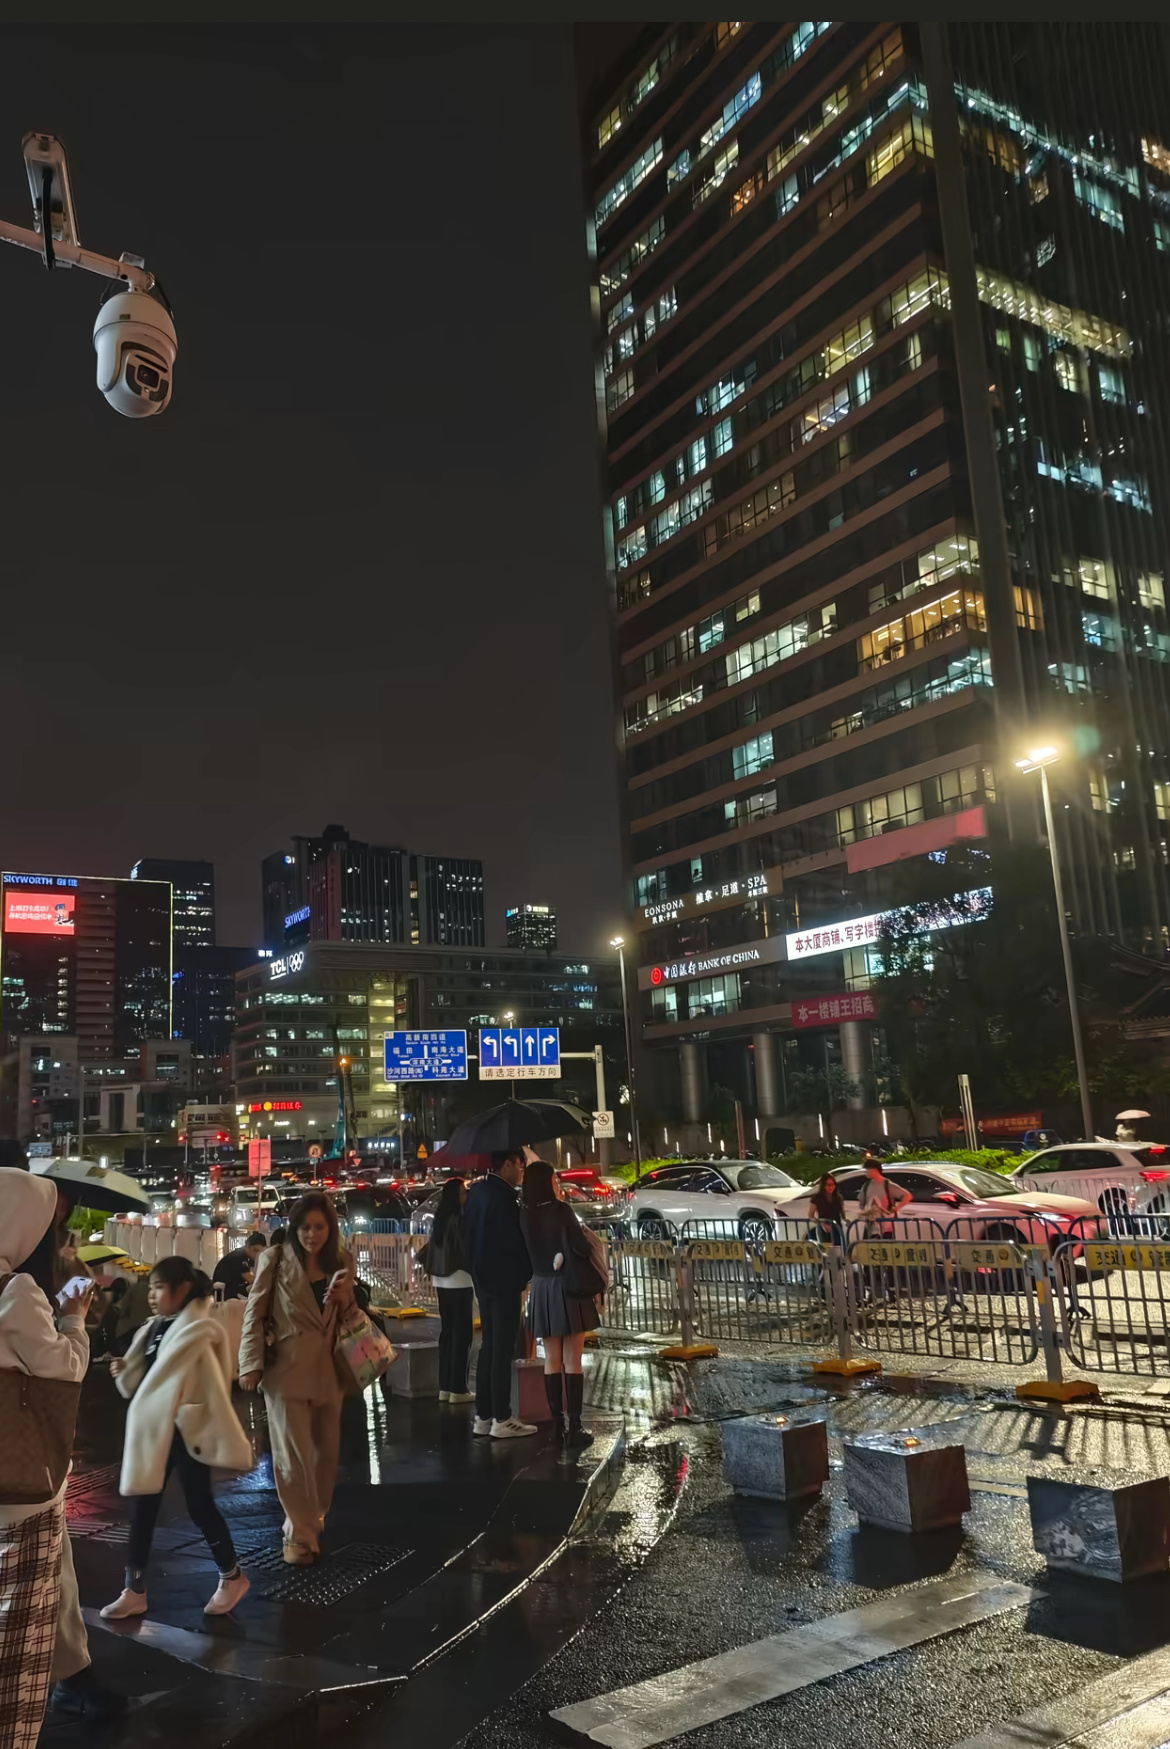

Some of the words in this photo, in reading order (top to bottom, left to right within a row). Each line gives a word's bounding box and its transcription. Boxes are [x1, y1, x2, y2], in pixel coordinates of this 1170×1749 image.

[3, 875, 53, 885] SKYWORTH
[644, 899, 685, 918] EONSONA
[270, 958, 287, 976] TCL
[663, 961, 697, 979] 中国银行
[698, 958, 720, 971] BANK
[720, 955, 731, 966] OF
[732, 949, 760, 964] CHINA
[798, 995, 874, 1022] 本一楼铺王招商
[485, 1067, 557, 1078] 请选定行车方向
